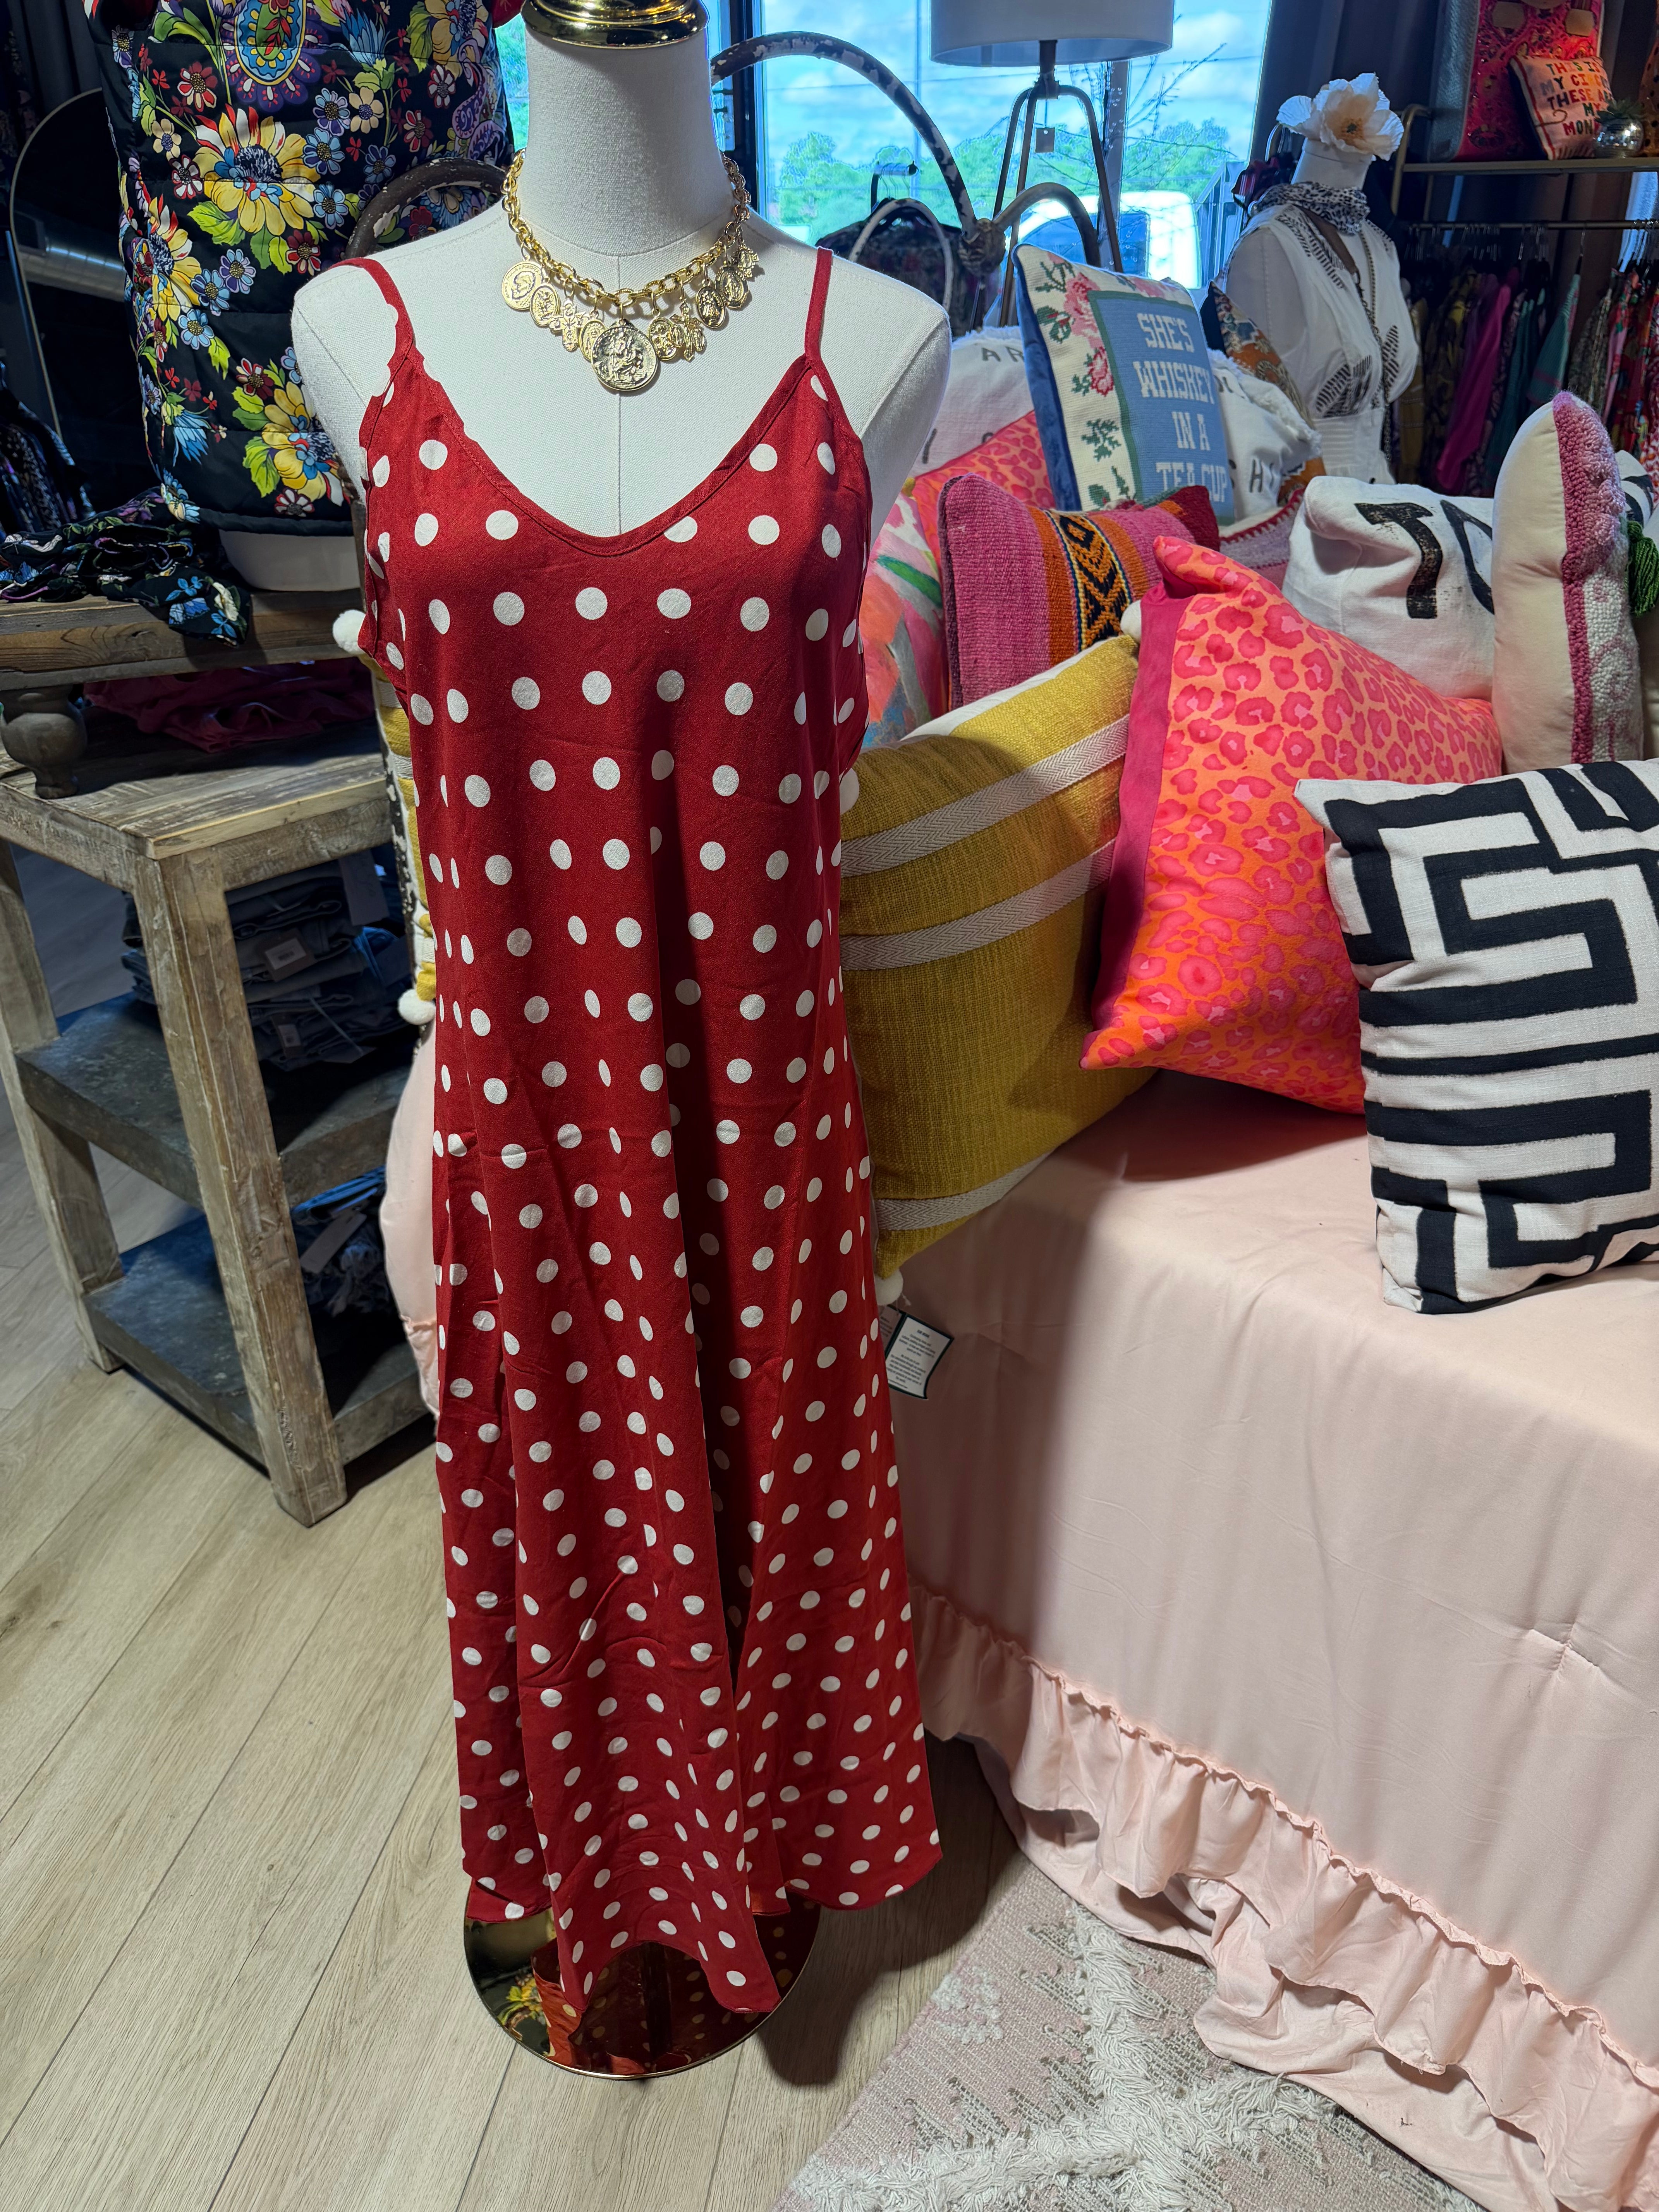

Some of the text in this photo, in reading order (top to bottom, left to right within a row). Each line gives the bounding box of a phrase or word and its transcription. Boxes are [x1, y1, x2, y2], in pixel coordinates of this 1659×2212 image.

[1540, 76, 1563, 96] MY
[1546, 61, 1601, 75] THIS IS
[1547, 88, 1595, 110] THESE
[1137, 313, 1195, 352] SHE'S
[1133, 361, 1215, 404] WHISKEY
[1172, 411, 1211, 451] IN A
[1156, 462, 1196, 492] TEA
[1201, 465, 1228, 503] CUP
